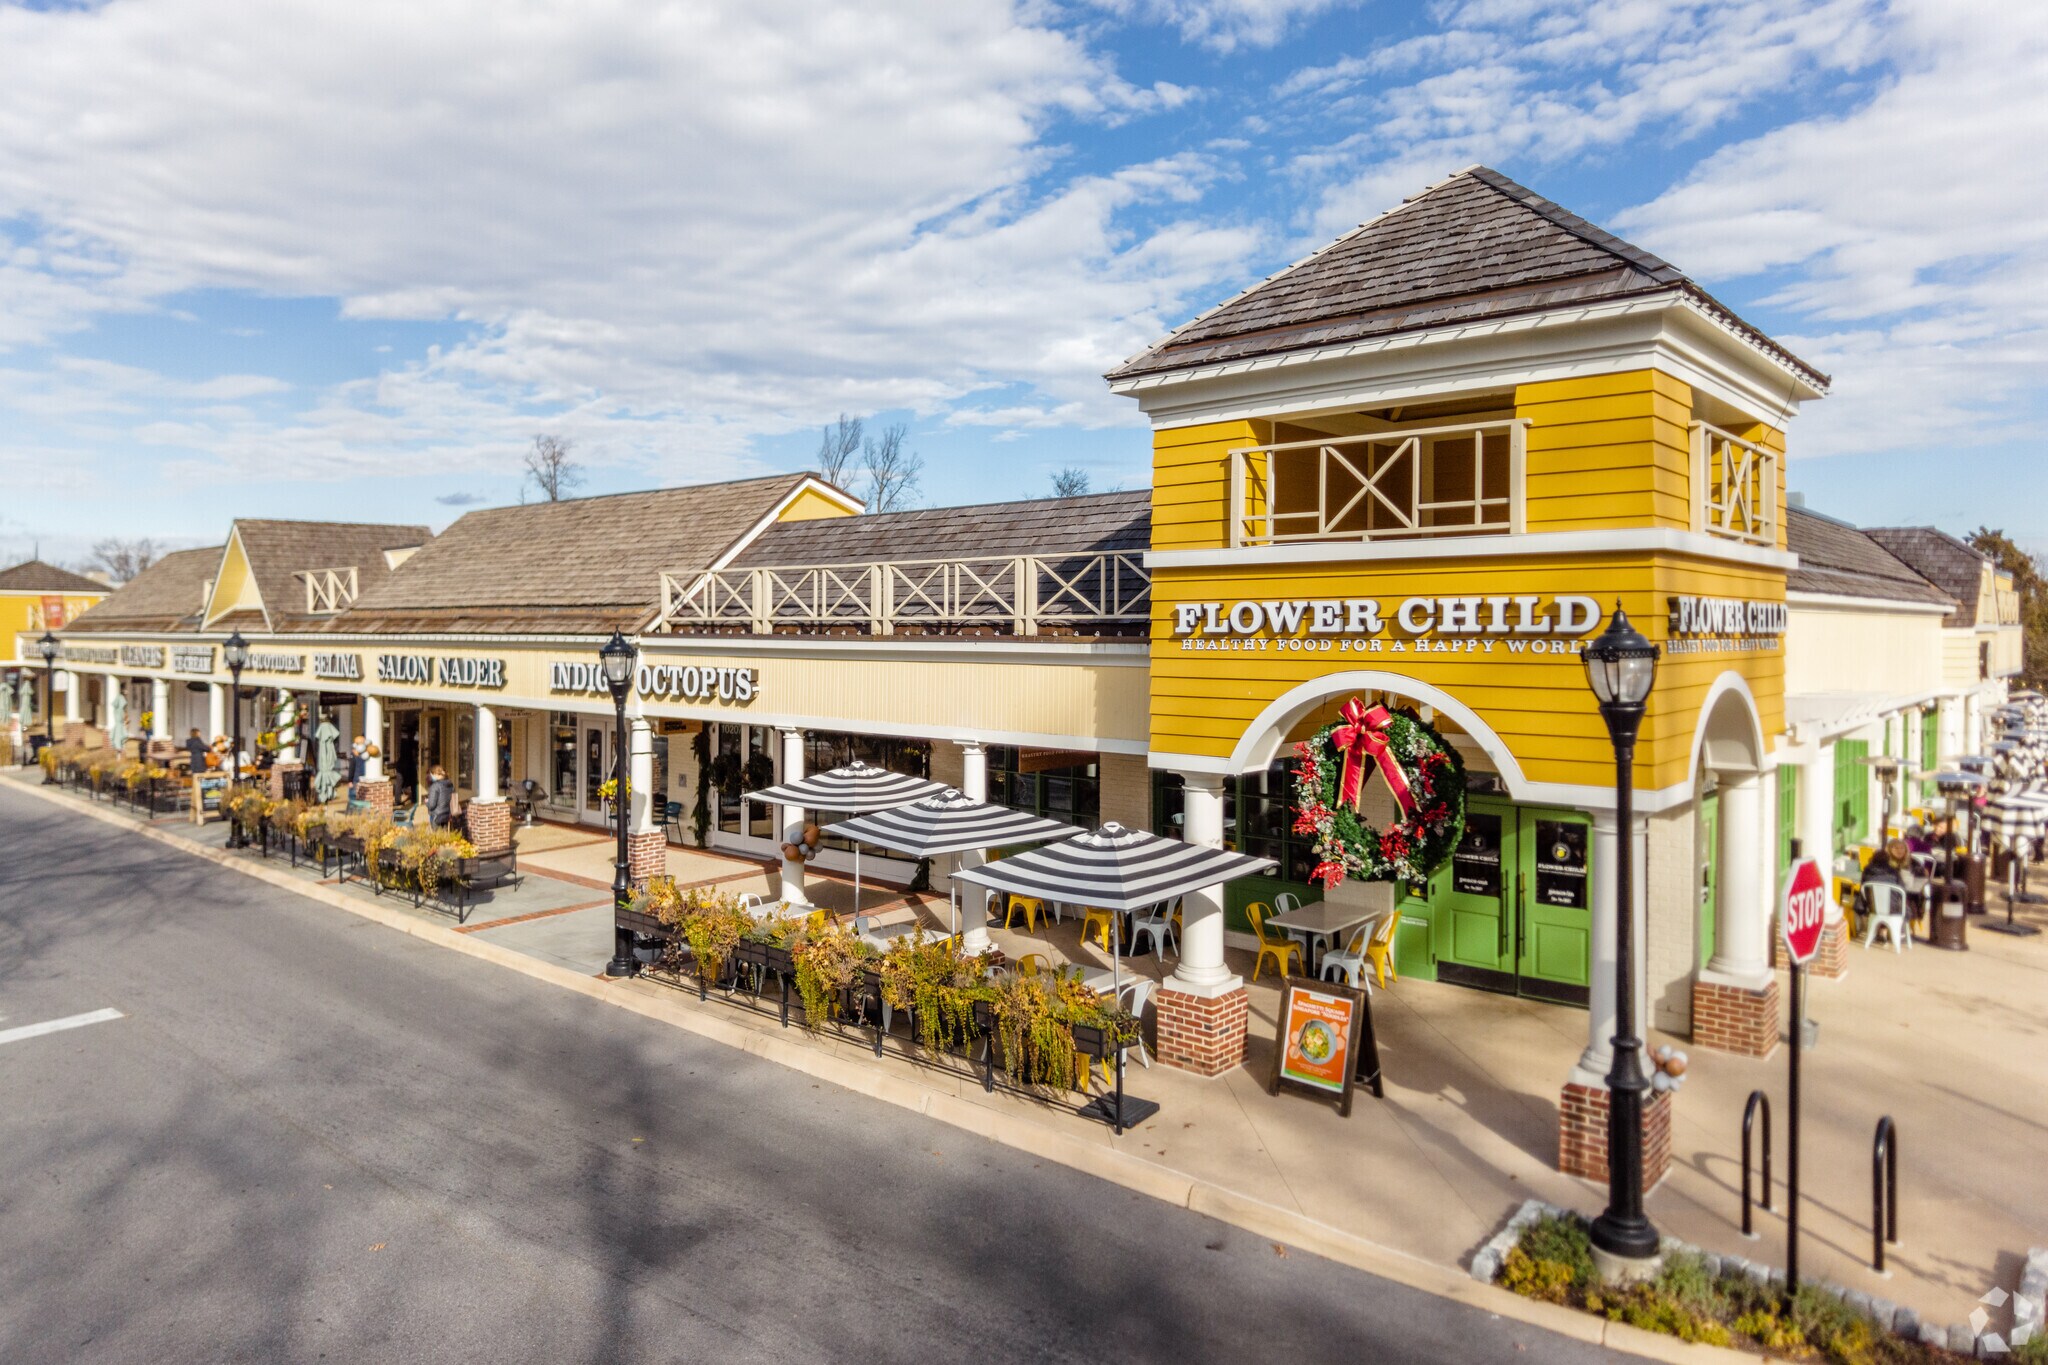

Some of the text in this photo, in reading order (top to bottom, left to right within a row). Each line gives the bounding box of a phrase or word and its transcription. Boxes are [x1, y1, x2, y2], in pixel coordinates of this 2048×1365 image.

[1174, 595, 1602, 634] FLOWER CHILD
[1678, 595, 1789, 634] FLOWER CHILD
[252, 653, 301, 671] QUOTIDIEN
[1181, 638, 1270, 651] HEALTHY
[1276, 638, 1332, 652] FOOD
[1339, 638, 1383, 652] FOR
[1390, 639, 1406, 653] A
[1414, 638, 1496, 653] HAPPY
[313, 652, 360, 678] BELINA
[377, 654, 503, 687] SALON NADER
[549, 661, 753, 701] INDIG OCTOPUS
[1788, 887, 1824, 935] STOP
